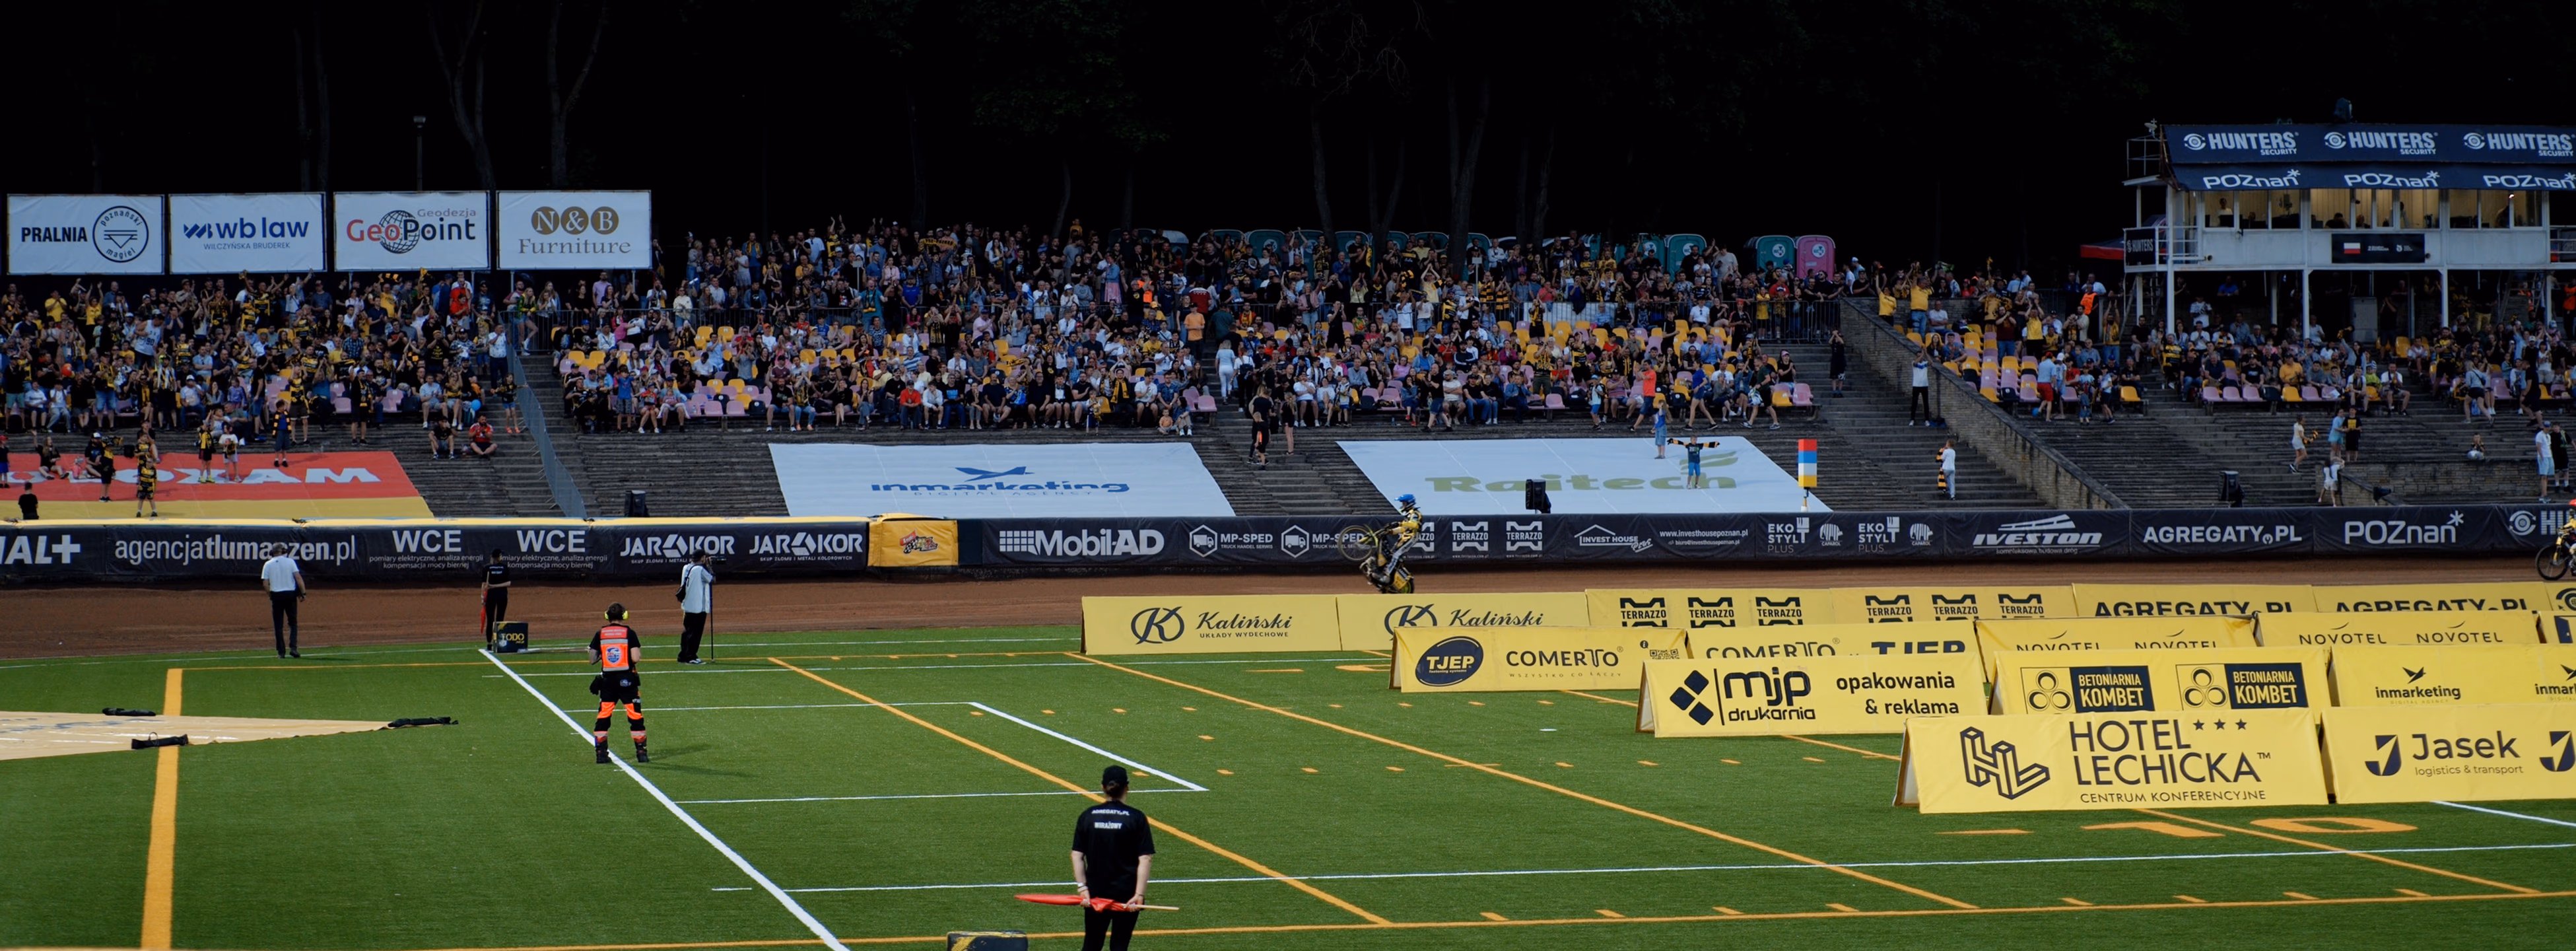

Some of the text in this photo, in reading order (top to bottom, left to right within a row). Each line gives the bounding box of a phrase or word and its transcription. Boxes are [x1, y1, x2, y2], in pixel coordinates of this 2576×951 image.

[2208, 132, 2297, 150] HUNTERS
[2348, 132, 2435, 149] HUNTERS
[2487, 133, 2573, 151] HUNTERS
[100, 209, 143, 227] poznański
[417, 208, 476, 217] Geodezja
[216, 217, 309, 238] wb law
[347, 217, 475, 241] GeoPoint
[21, 227, 88, 242] PRALNIA
[518, 238, 630, 254] Furniture
[106, 248, 136, 260] magiel
[871, 481, 1130, 493] inmarketing
[1425, 470, 1737, 493] Raitech
[1660, 529, 1748, 539] www.investhousepoznan.pl
[1768, 524, 1794, 533] EKO
[1858, 523, 1885, 532] EKO
[392, 530, 461, 553] WCE
[517, 530, 586, 553] WCE
[1221, 534, 1273, 543] MP-SPED
[1768, 534, 1799, 544] STYL
[1858, 534, 1889, 543] STYL
[1973, 532, 2102, 546] IVESTON
[115, 534, 355, 566] agencjatlumazen.pl
[1768, 545, 1794, 553] PLUS
[1858, 544, 1884, 553] PLUS
[461, 554, 483, 563] energii
[586, 554, 607, 563] energii
[508, 561, 550, 570] kompensacja
[1621, 610, 1667, 619] TERRAZZO
[1689, 609, 1734, 618] TERRAZZO
[1757, 608, 1802, 617] TERRAZZO
[1867, 606, 1912, 616] TERRAZZO
[1934, 606, 1978, 615] TERRAZZO
[2000, 605, 2044, 614] TERRAZZO
[1196, 612, 1292, 629] Kaliński
[1449, 609, 1543, 626] Kaliński
[2299, 633, 2387, 645] NOVOTEL
[2417, 632, 2503, 644] NOVOTEL
[1427, 656, 1475, 669] TJEP
[1507, 649, 1619, 667] COMERTO
[1837, 672, 1955, 693] opakowania
[2078, 674, 2141, 686] BETONIARNIA
[2233, 671, 2295, 684] BETONIARNIA
[1724, 666, 1811, 706] mjp
[2375, 685, 2460, 699] inmarketing
[2080, 687, 2144, 708] KOMBET
[2235, 685, 2298, 705] KOMBET
[1866, 698, 1959, 715] & reklama
[1728, 707, 1815, 721] drukarnia
[2069, 718, 2191, 752] HOTEL
[2412, 730, 2521, 760] Jasek
[2415, 765, 2460, 777] logistics
[2473, 765, 2524, 775] transport
[2080, 791, 2266, 803] CENTRUM KONFERENCYJNE
